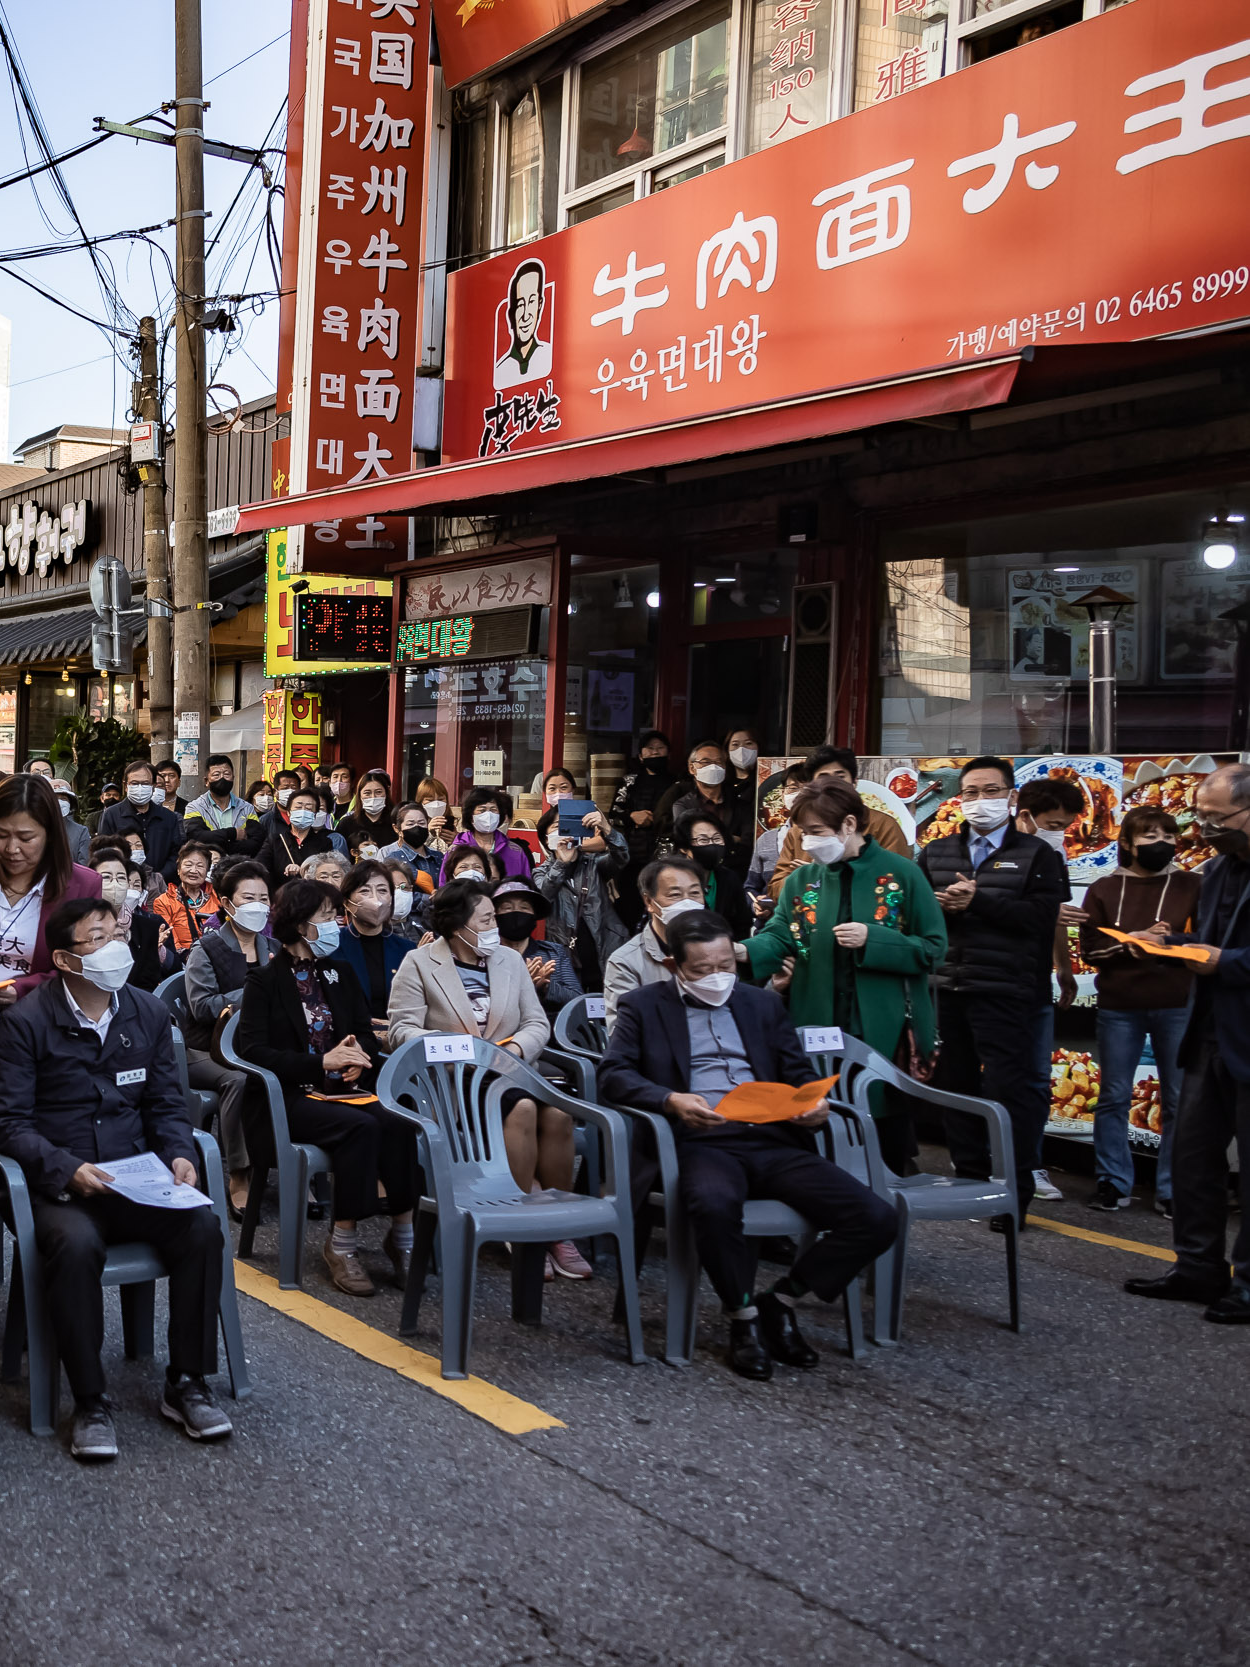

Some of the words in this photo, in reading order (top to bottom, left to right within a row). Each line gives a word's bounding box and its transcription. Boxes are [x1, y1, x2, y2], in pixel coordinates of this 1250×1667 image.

[590, 38, 1250, 337] 牛肉面大王
[946, 301, 1087, 359] 가맹/예약문의
[1095, 296, 1121, 325] 02
[1128, 280, 1183, 317] 6465
[1191, 265, 1249, 304] 8999
[590, 314, 768, 412] 우육면대왕
